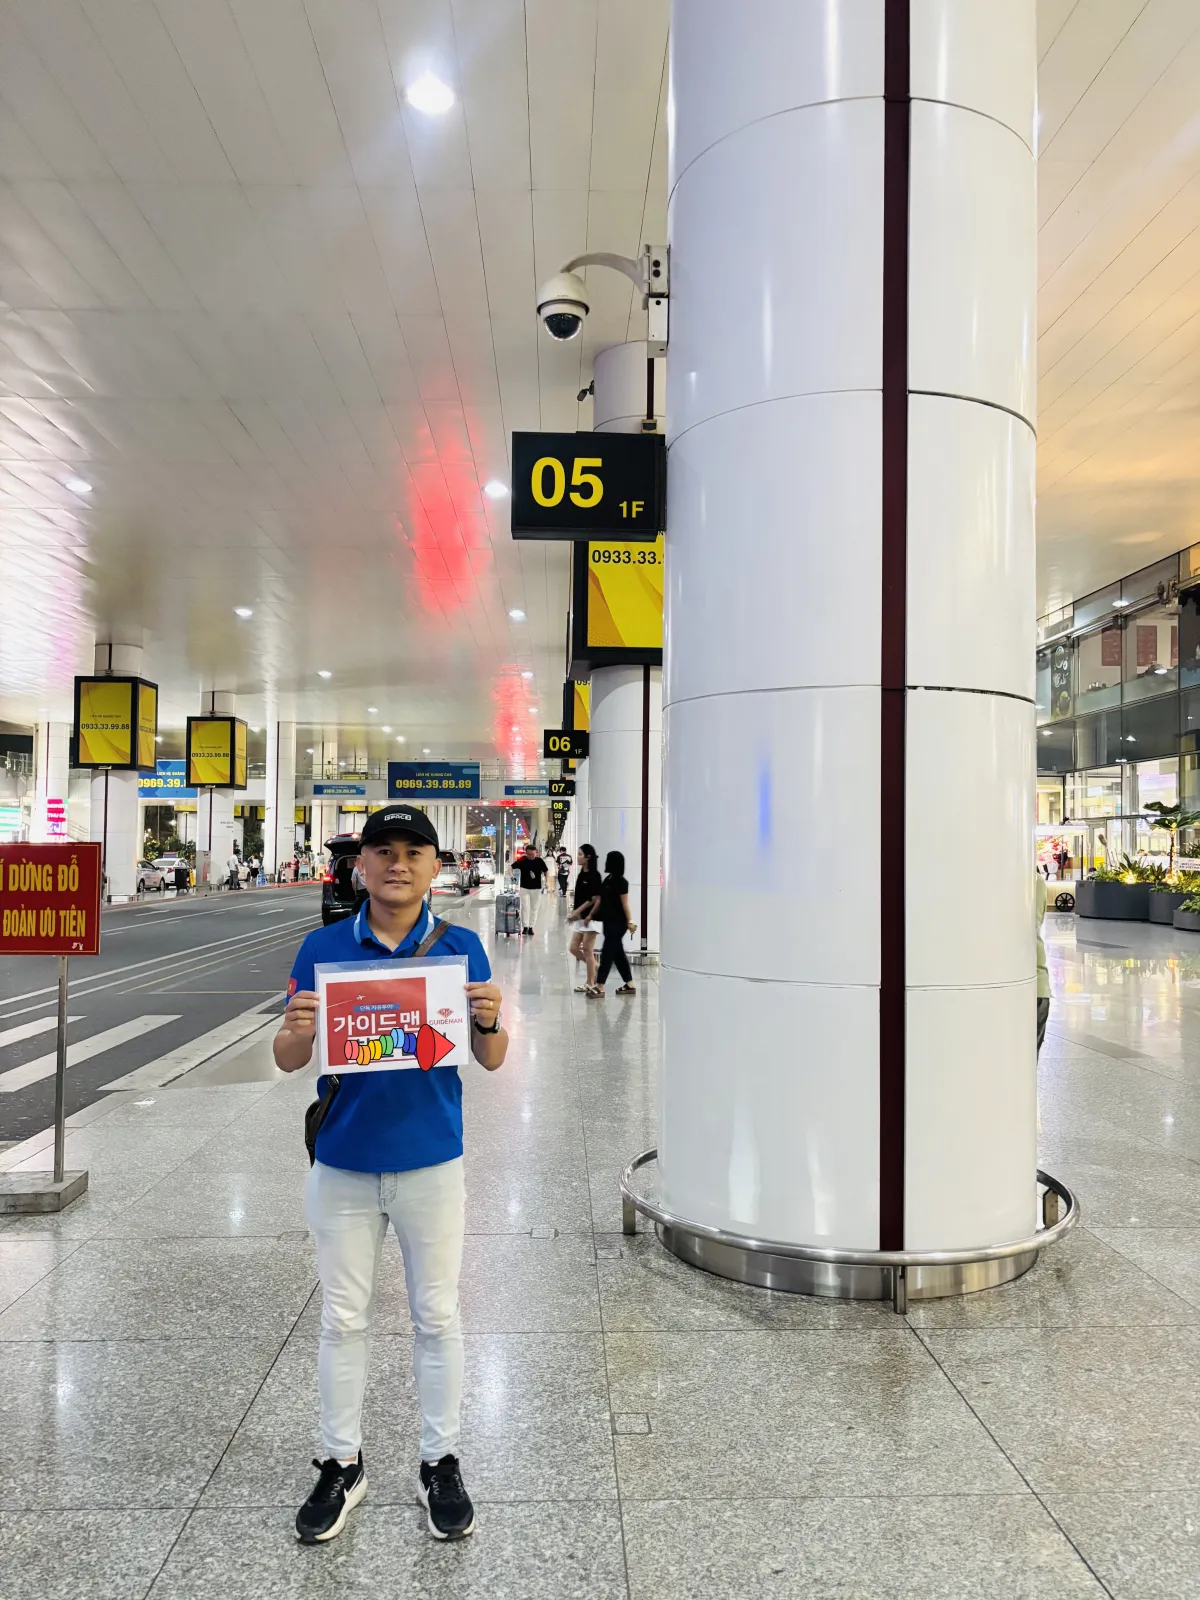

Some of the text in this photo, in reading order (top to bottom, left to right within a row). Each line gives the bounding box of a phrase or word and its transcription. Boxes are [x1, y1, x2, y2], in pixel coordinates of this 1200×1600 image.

[531, 456, 645, 518] 05 1F
[592, 550, 664, 565] 0933.33.
[549, 736, 571, 752] 06
[138, 778, 186, 788] 0969.39.
[395, 779, 472, 789] 0969.39.89.89
[551, 783, 566, 793] 07
[553, 802, 563, 810] 08
[8, 858, 53, 892] DỪNG
[57, 854, 79, 892] ĐỖ
[2, 904, 86, 937] ĐOÀN ƯU TIÊN
[333, 1010, 420, 1036] 가이드맨
[428, 1017, 463, 1026] GUIDEMAN
